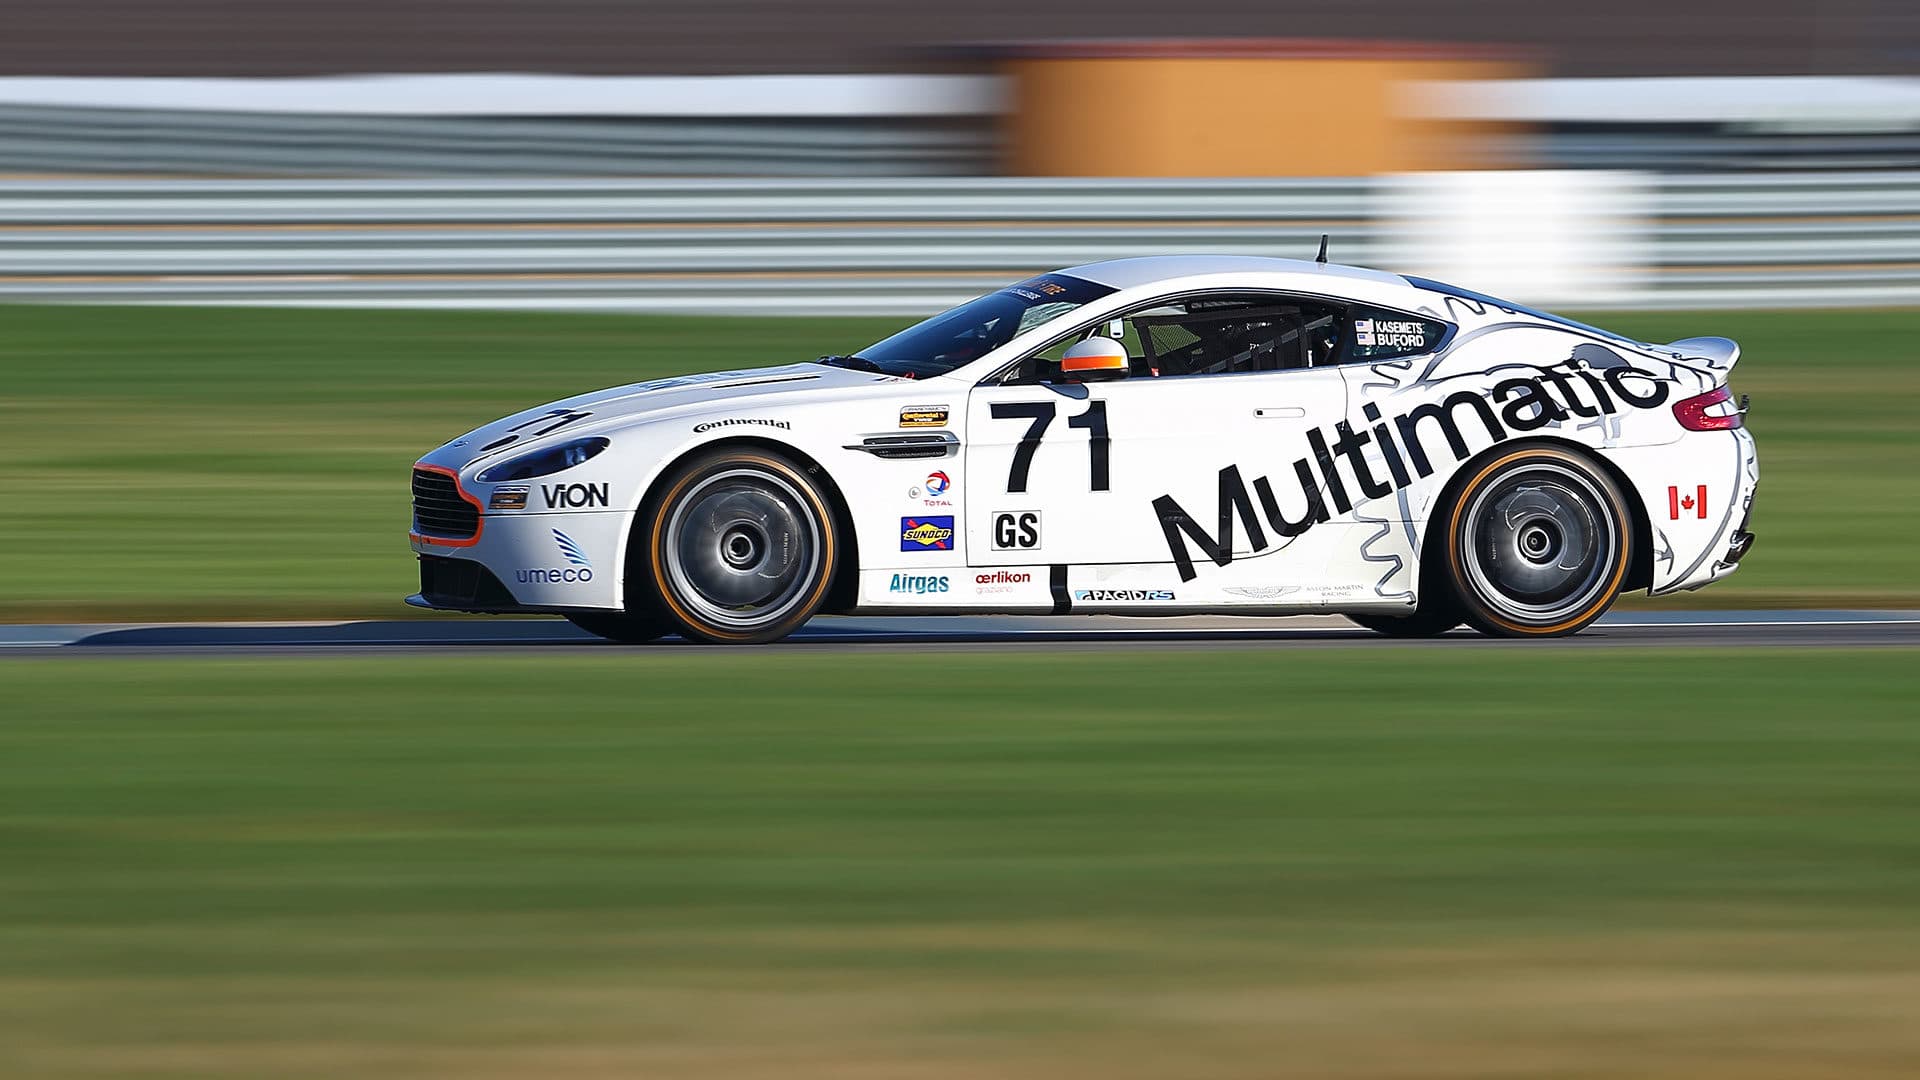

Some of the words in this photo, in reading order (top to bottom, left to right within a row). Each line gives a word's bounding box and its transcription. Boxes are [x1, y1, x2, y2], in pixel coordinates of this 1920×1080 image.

[1377, 334, 1425, 347] BUFORD
[693, 418, 792, 433] Continental
[989, 400, 1111, 493] 71
[1152, 358, 1669, 582] Multimatic
[924, 499, 953, 507] TOTAL
[906, 529, 949, 540] SUNOCO
[995, 512, 1038, 548] GS
[516, 567, 593, 584] umeco
[889, 573, 950, 595] Airgas
